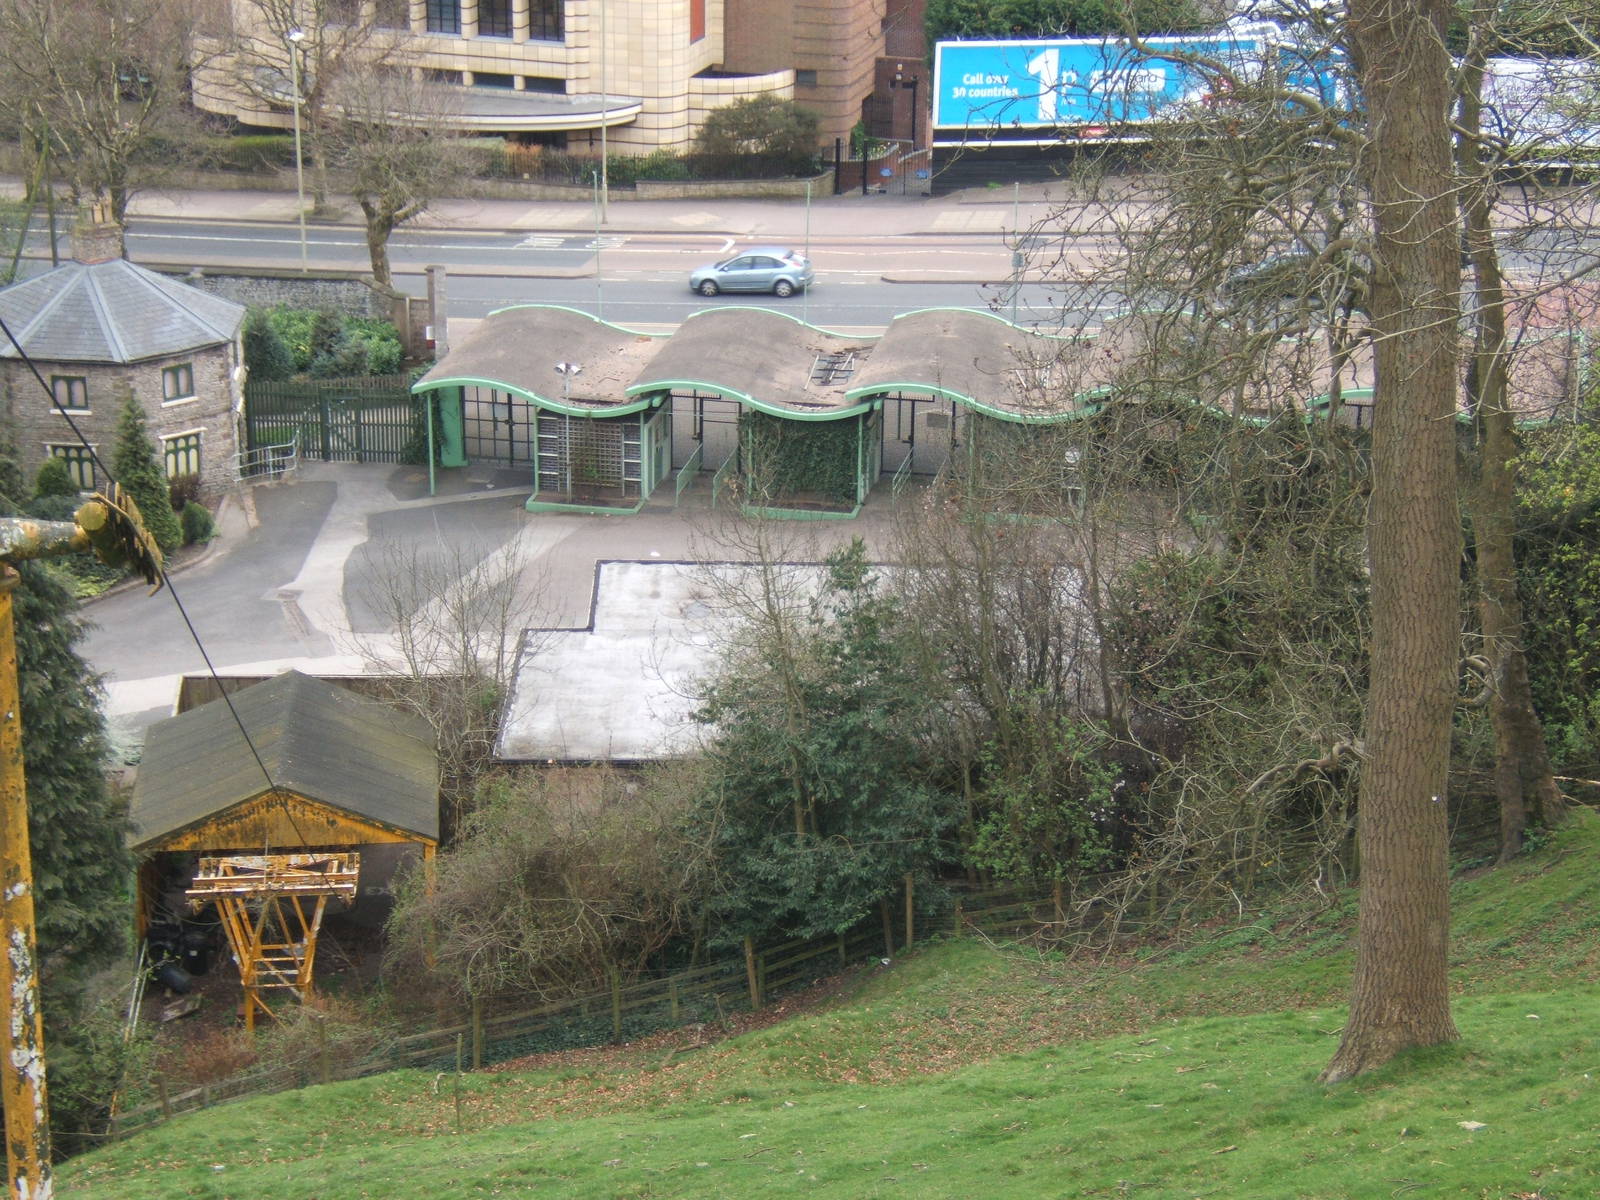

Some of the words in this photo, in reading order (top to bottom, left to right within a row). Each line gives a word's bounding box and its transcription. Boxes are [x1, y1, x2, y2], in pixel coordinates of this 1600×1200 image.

[962, 73, 984, 85] Call
[952, 87, 966, 99] 30
[968, 86, 1019, 98] countries
